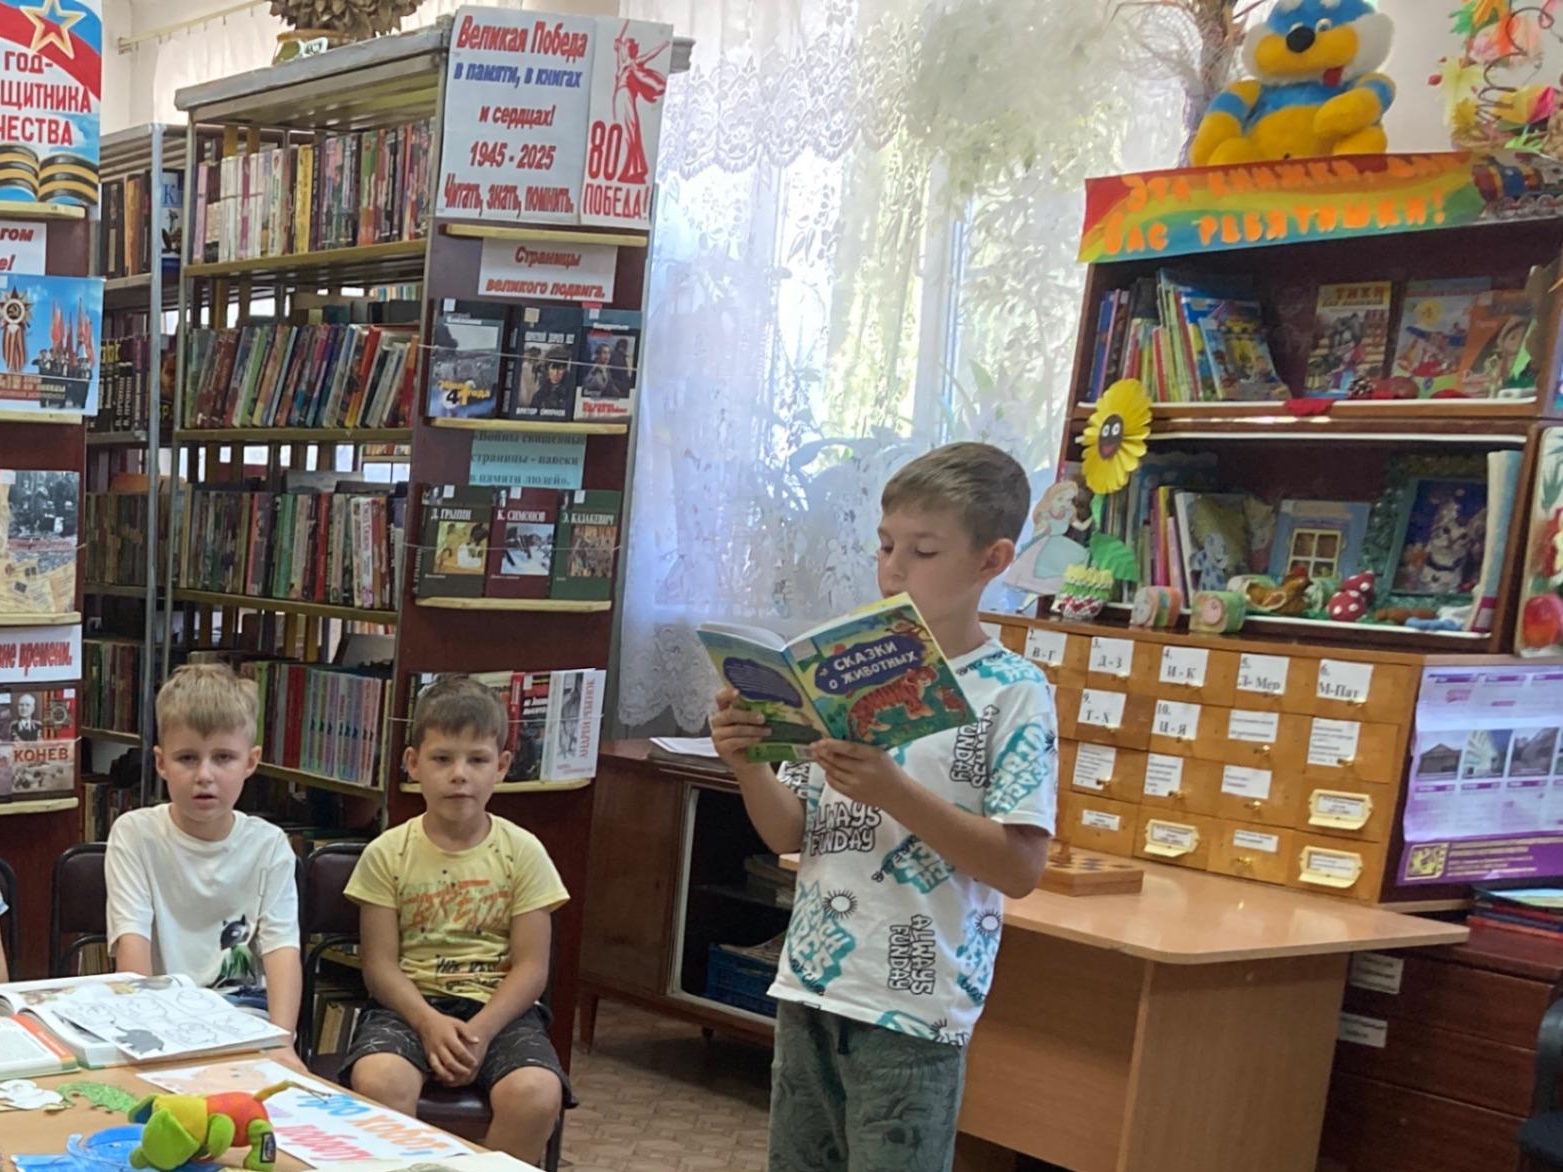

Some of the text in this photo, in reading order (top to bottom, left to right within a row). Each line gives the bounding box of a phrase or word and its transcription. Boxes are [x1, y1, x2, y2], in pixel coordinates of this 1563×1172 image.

[456, 15, 588, 63] Великая Победа
[454, 62, 582, 88] в памяти, в книгах
[492, 105, 556, 130] сердцах!
[469, 141, 507, 168] 1945
[517, 144, 556, 170] 2025
[588, 120, 623, 181] 80
[583, 184, 650, 220] ПОБЕДА!
[1104, 210, 1168, 254] ВАС
[515, 246, 581, 269] Страницы
[485, 279, 605, 300] великого подвига.
[833, 641, 898, 671] СКАЗКИ
[841, 651, 919, 684] ЖИВОТНЫХ
[1256, 677, 1280, 690] Мер
[1158, 704, 1171, 715] 10.
[14, 748, 68, 762] КОНЕВ
[949, 724, 978, 782] UNDAY
[888, 924, 912, 990] FUNDAY
[911, 914, 936, 995] ALWAYS
